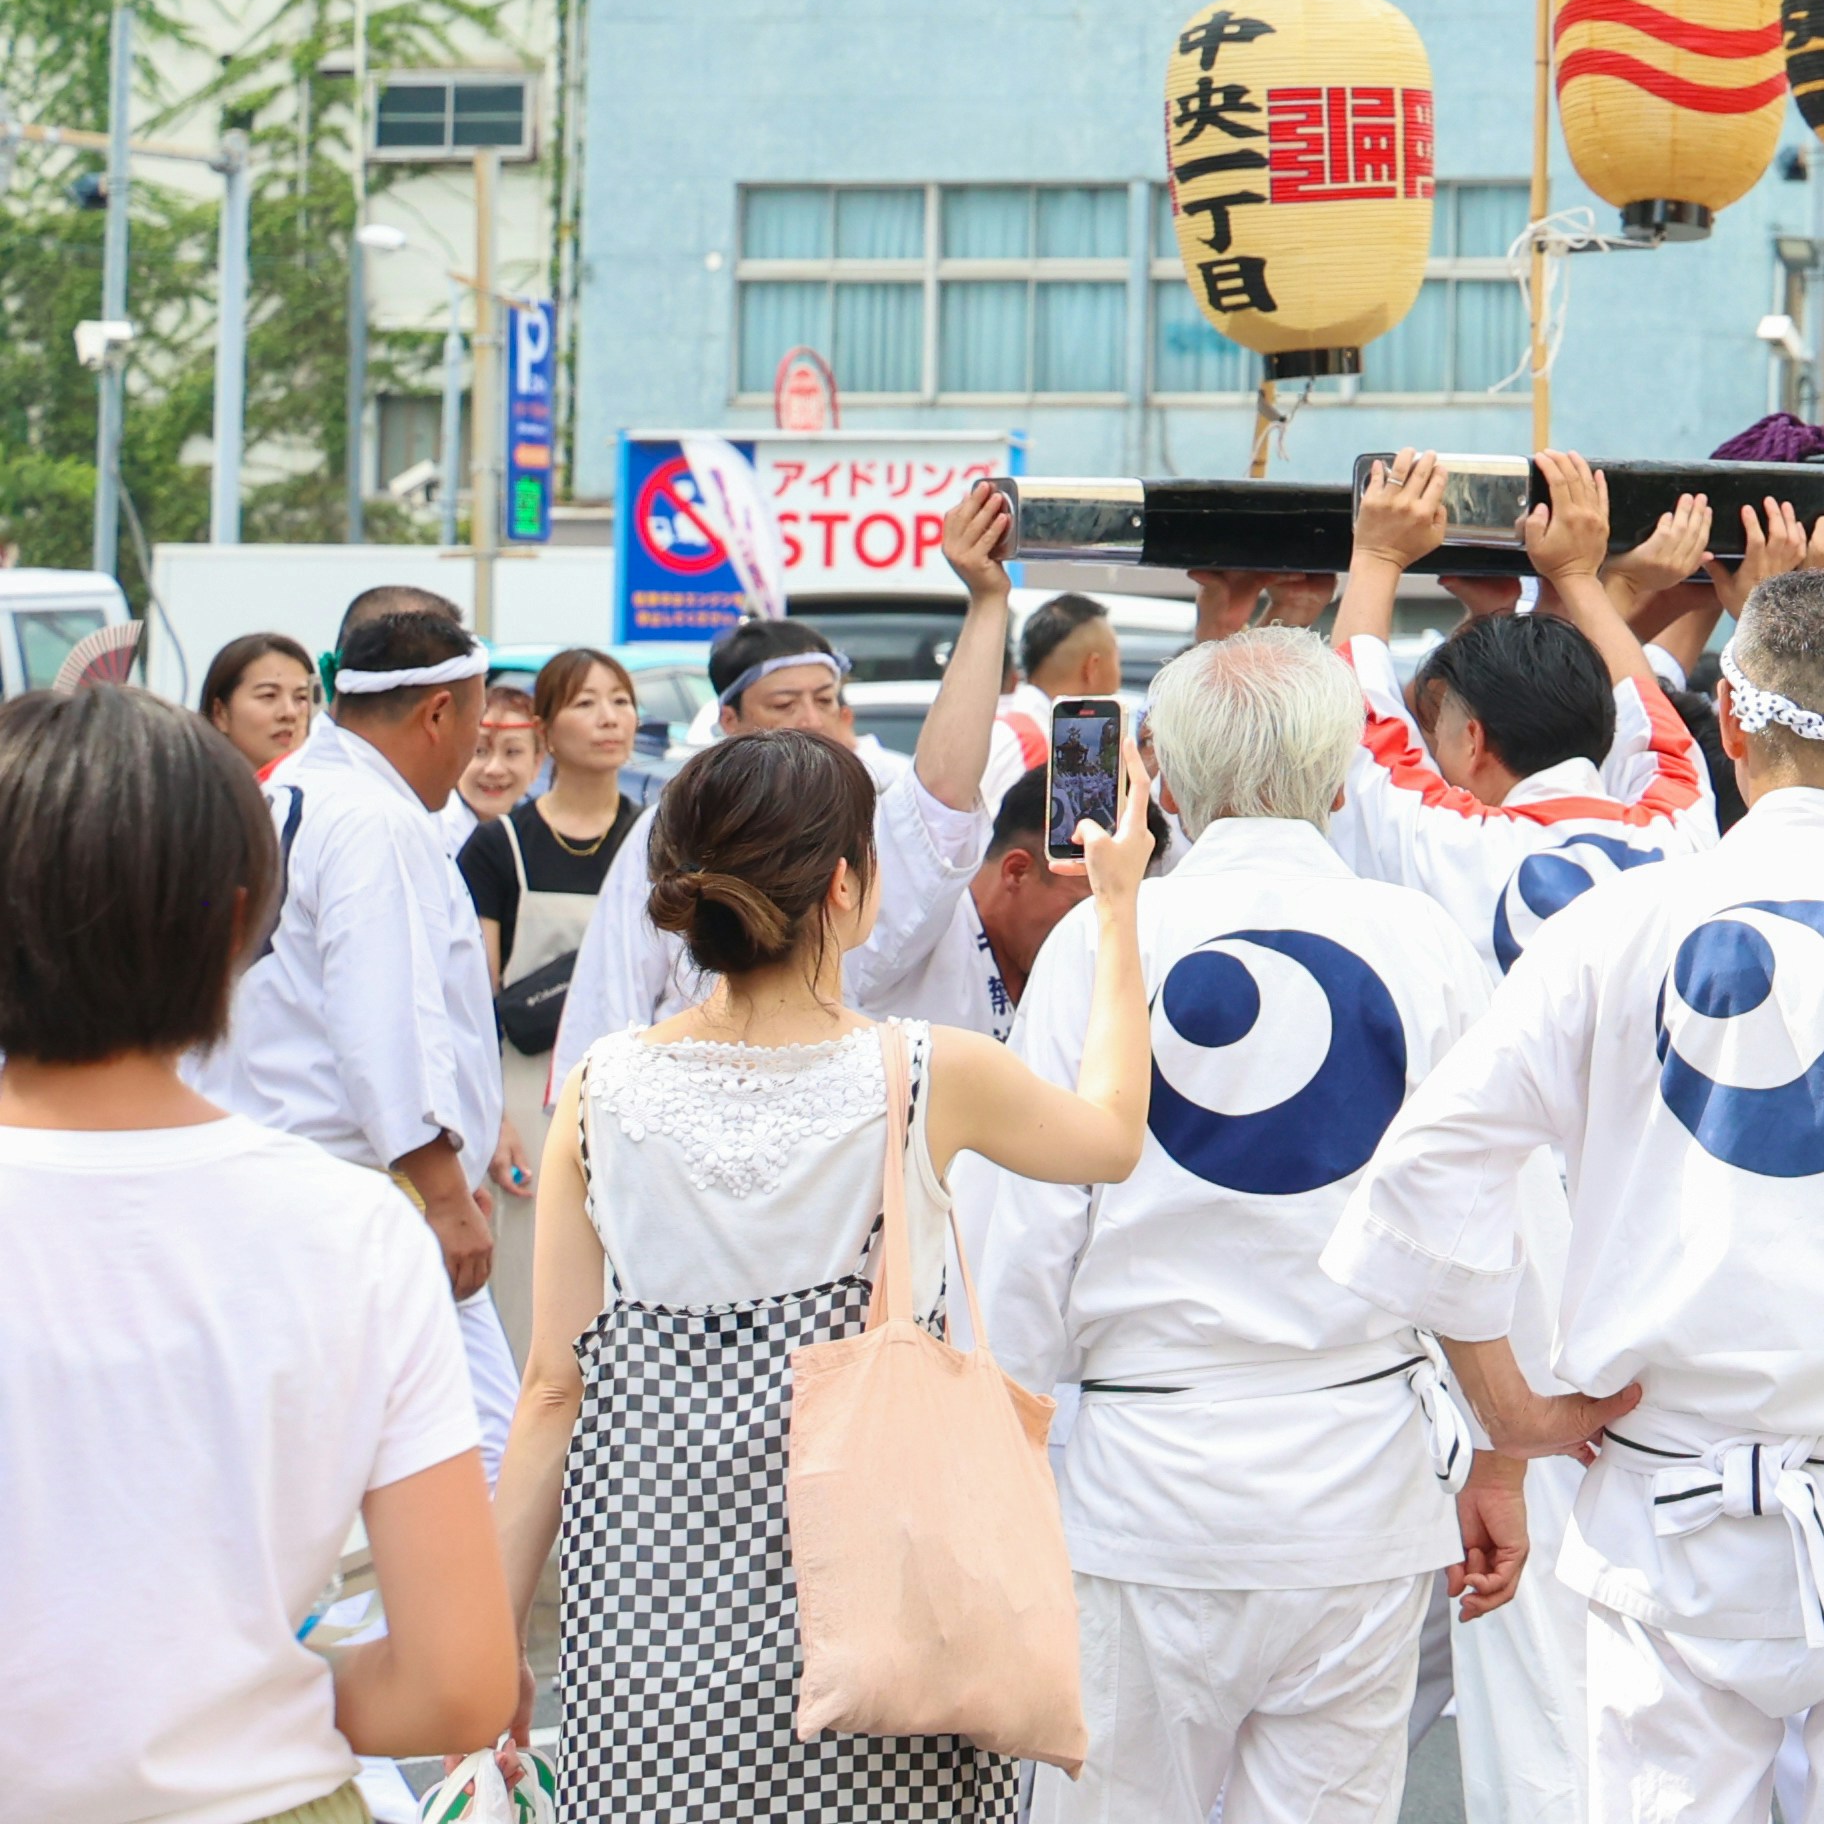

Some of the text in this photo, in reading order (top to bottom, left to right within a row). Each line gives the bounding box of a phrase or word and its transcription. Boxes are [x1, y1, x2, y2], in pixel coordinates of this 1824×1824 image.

[1173, 10, 1278, 314] 中央一丁目
[777, 511, 945, 569] STOP
